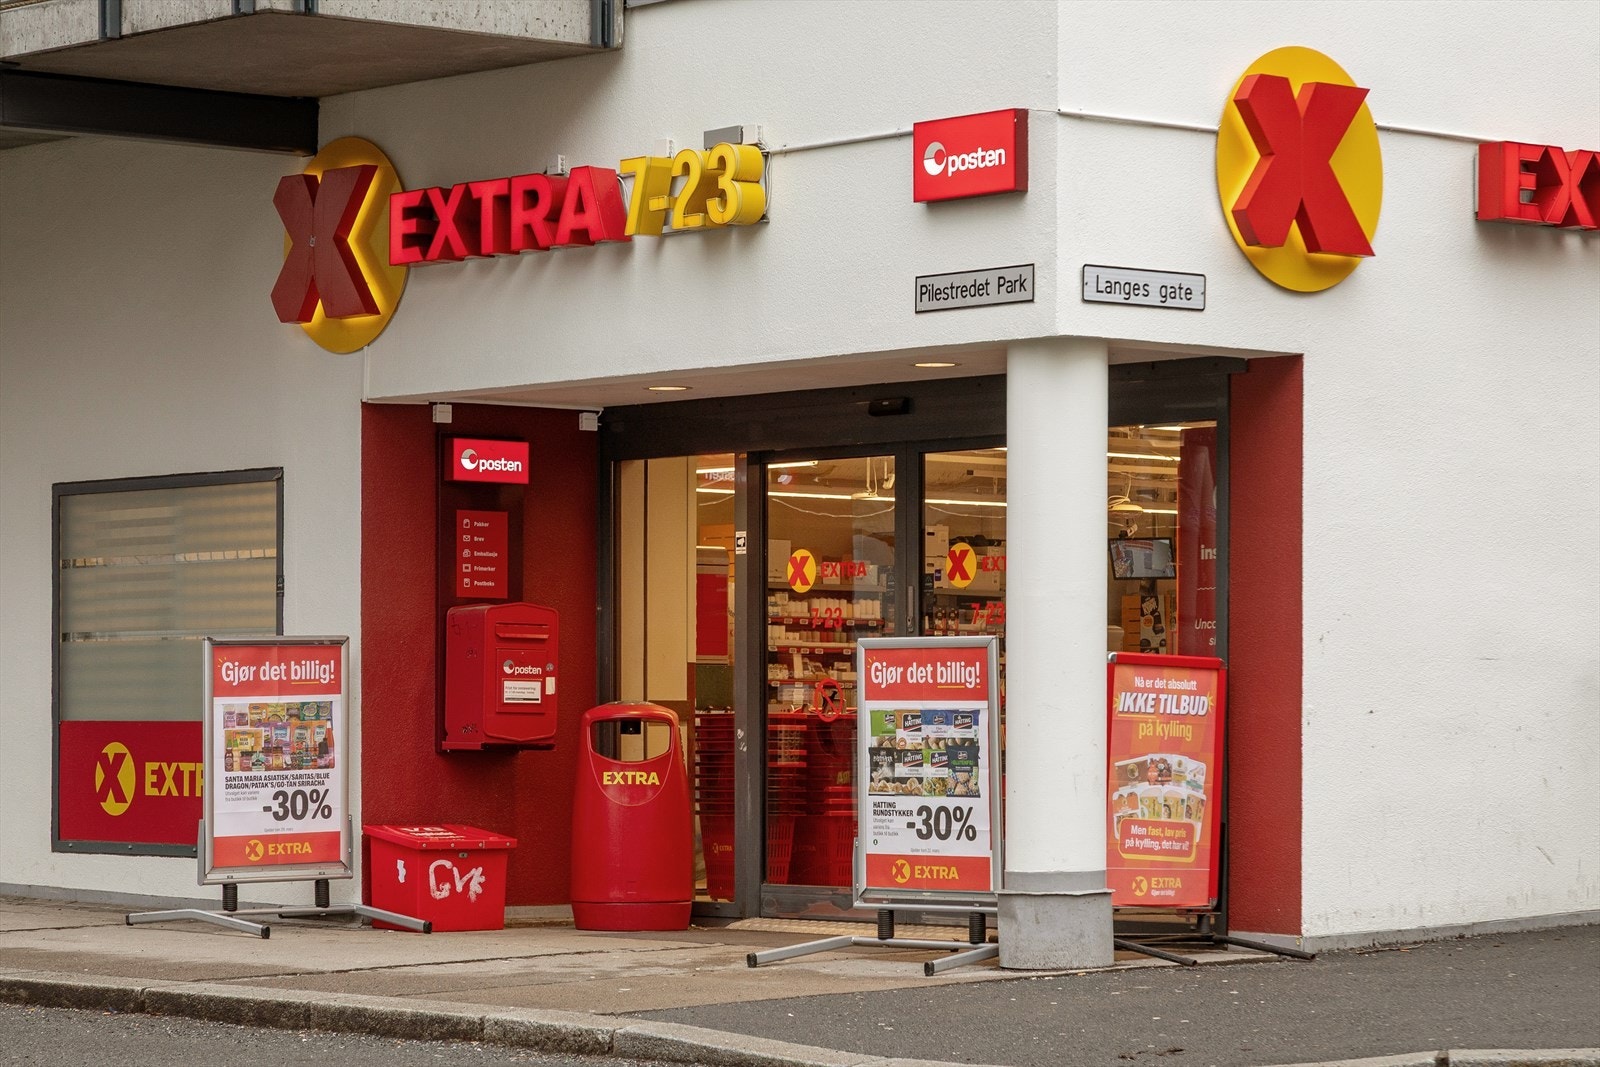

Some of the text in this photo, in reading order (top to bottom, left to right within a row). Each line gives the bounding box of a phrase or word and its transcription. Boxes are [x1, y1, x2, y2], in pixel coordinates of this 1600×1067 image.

[947, 145, 1006, 178] posten
[1488, 141, 1600, 231] EX
[389, 165, 630, 266] EXTRA
[620, 142, 766, 236] 7-23
[919, 275, 1027, 304] Pilestredet Park
[1095, 275, 1193, 304] Langes gate
[479, 457, 522, 473] posten
[820, 562, 867, 578] EXTRA
[811, 607, 843, 629] 7-23
[971, 601, 1005, 625] 7-23
[221, 660, 335, 686] Gjør det billig!
[514, 665, 542, 675] posten
[870, 661, 981, 689] Gjør det billig!
[1134, 676, 1197, 691] Nå er det absolutt
[1119, 692, 1209, 716] IKKE TILBUD
[1138, 720, 1193, 742] på kylling
[225, 775, 244, 783] SANTA
[244, 774, 263, 782] MARIA
[602, 771, 660, 786] EXTRA
[262, 788, 332, 822] -30%
[872, 801, 897, 809] HATTING
[872, 809, 914, 817] RUNDSTYKKER
[906, 805, 977, 841] -30%
[1130, 825, 1147, 835] Men
[1147, 826, 1164, 837] fast,
[1164, 827, 1174, 837] lav
[268, 842, 312, 856] EXTRA
[1125, 838, 1134, 848] på
[1135, 838, 1161, 851] kylling,
[914, 865, 959, 880] EXTRA
[1151, 877, 1182, 889] EXTRA
